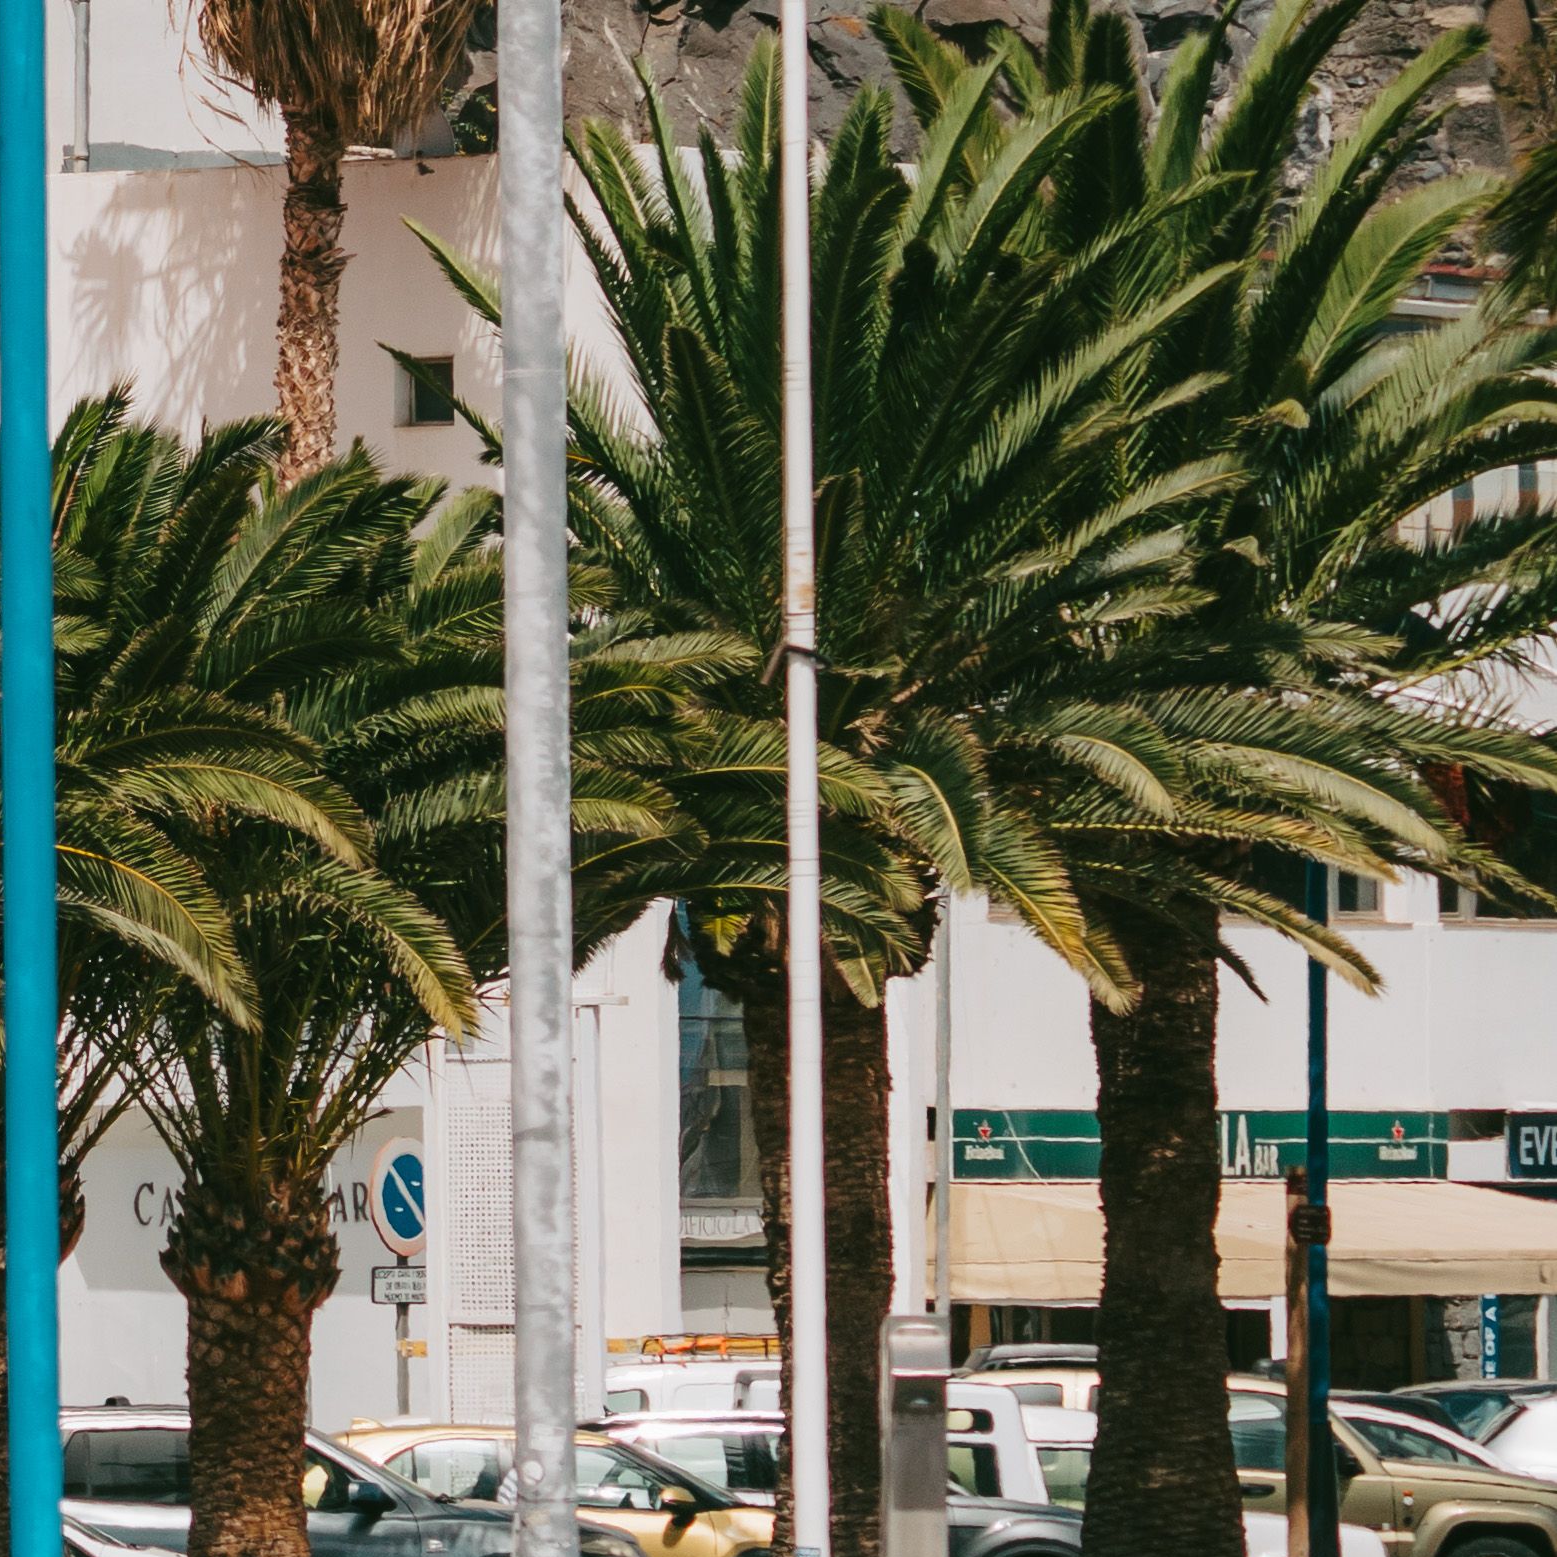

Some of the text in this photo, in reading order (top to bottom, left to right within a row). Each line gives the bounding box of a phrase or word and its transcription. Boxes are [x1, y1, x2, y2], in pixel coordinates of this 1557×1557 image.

[1221, 1113, 1279, 1176] LA BAR
[1484, 1326, 1496, 1357] OF
